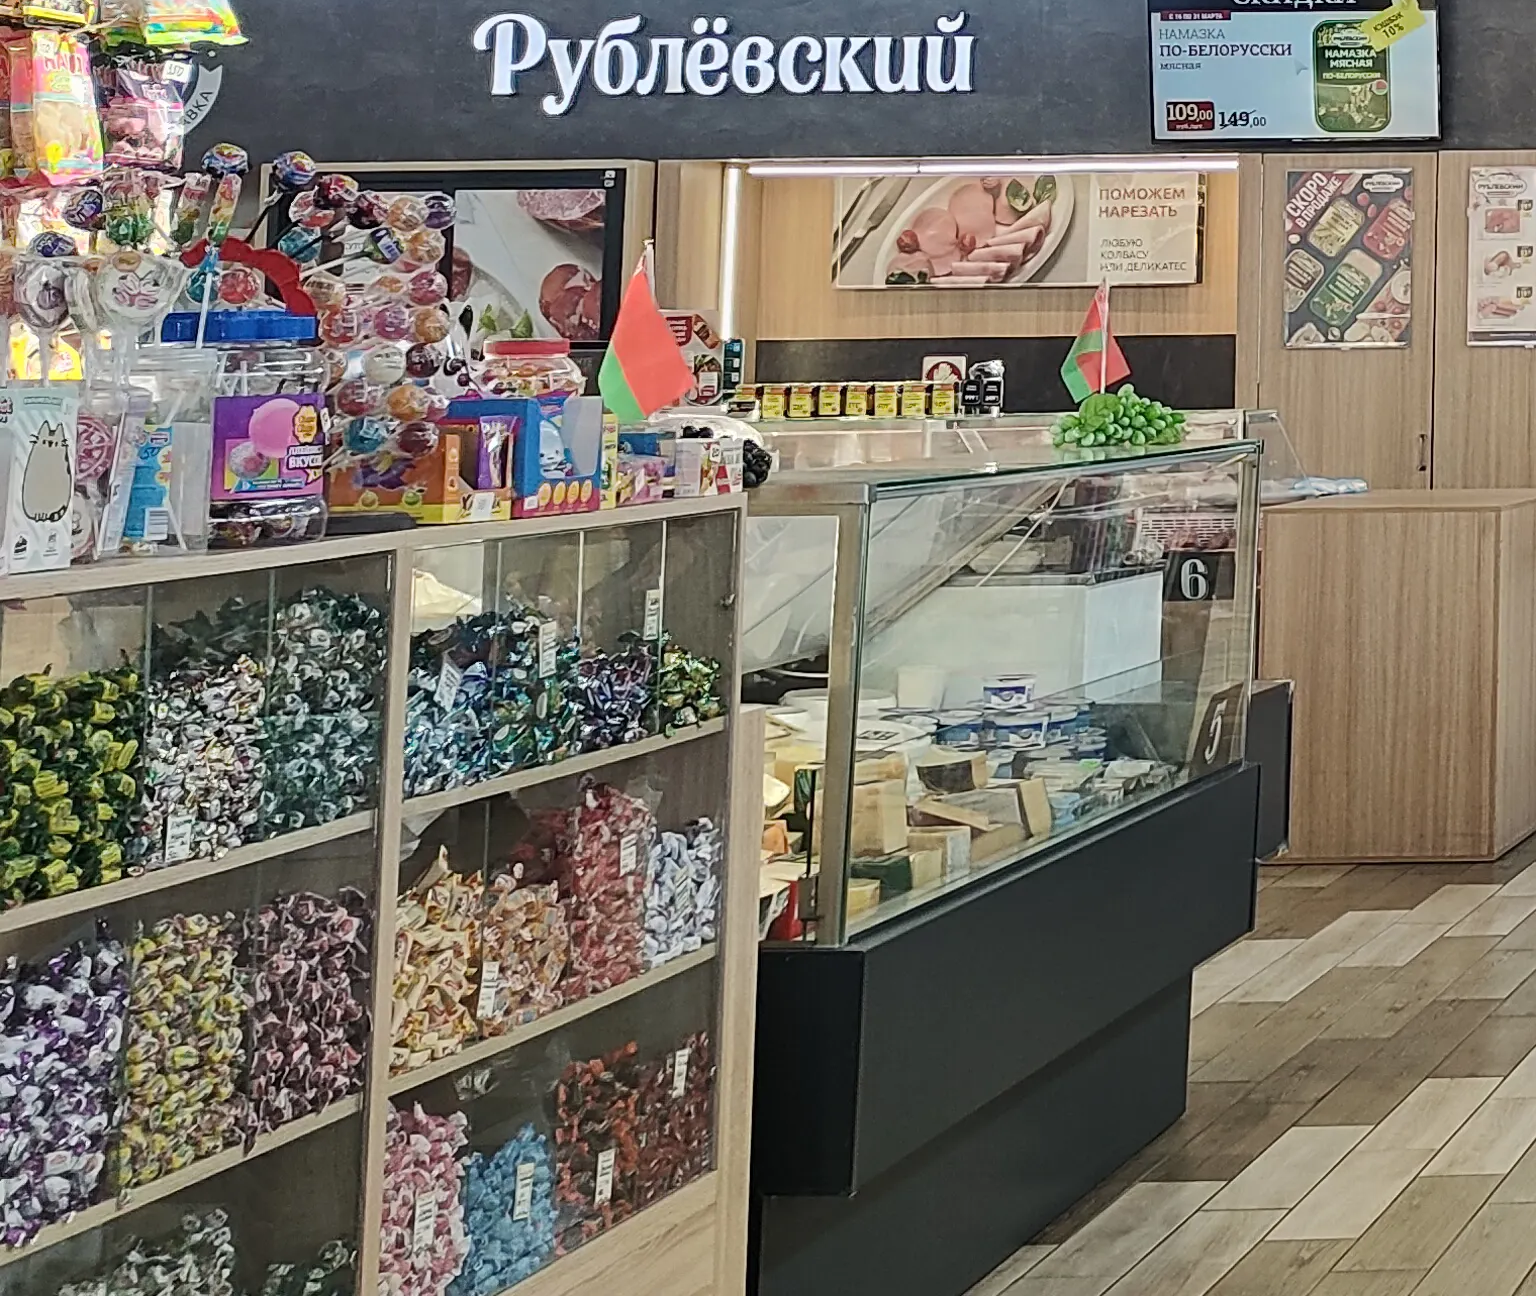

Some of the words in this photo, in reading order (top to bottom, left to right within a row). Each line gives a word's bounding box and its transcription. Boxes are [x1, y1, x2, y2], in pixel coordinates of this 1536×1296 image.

[1159, 28, 1225, 40] НАМАЗКА
[1159, 44, 1292, 57] ПО-БЕЛОРУССКИ
[1325, 49, 1377, 59] НАМАЗКА
[472, 11, 977, 116] Рублёвский
[1330, 59, 1373, 69] МЯСНАЯ
[1167, 104, 1213, 122] 109,00
[1099, 187, 1186, 201] ПОМОЖЕМ
[1286, 172, 1329, 217] СКОРО
[1098, 205, 1178, 218] НАРЕЗАТЬ
[1100, 238, 1143, 248] ЛЮБУЮ
[1100, 250, 1149, 260] КОЛБАСУ
[1100, 262, 1123, 272] ИЛИ
[1124, 261, 1188, 273] ДЕЛИКАТЕС
